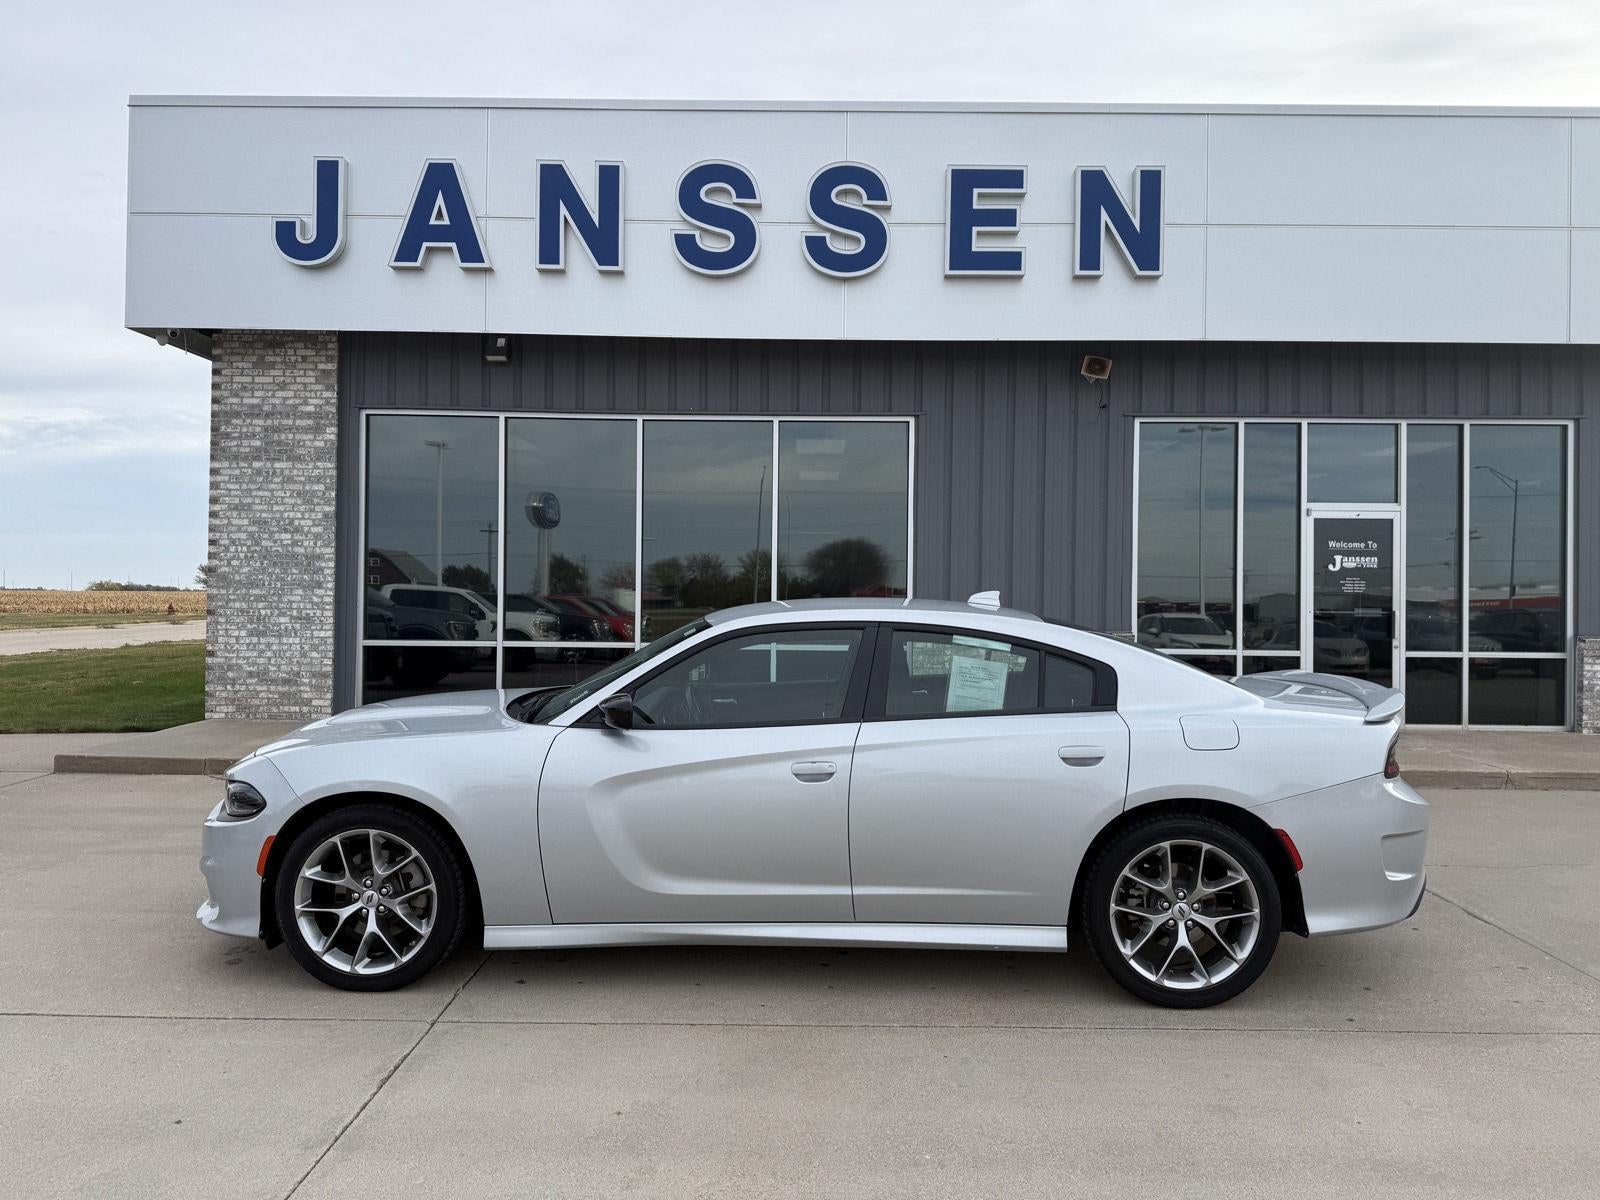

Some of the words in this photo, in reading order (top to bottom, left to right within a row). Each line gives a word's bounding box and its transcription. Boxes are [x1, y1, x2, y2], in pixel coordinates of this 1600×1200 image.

[271, 156, 1165, 279] JANSSEN
[1328, 540, 1365, 549] Welcome
[1367, 540, 1377, 549] To
[1328, 555, 1378, 571] Janssen
